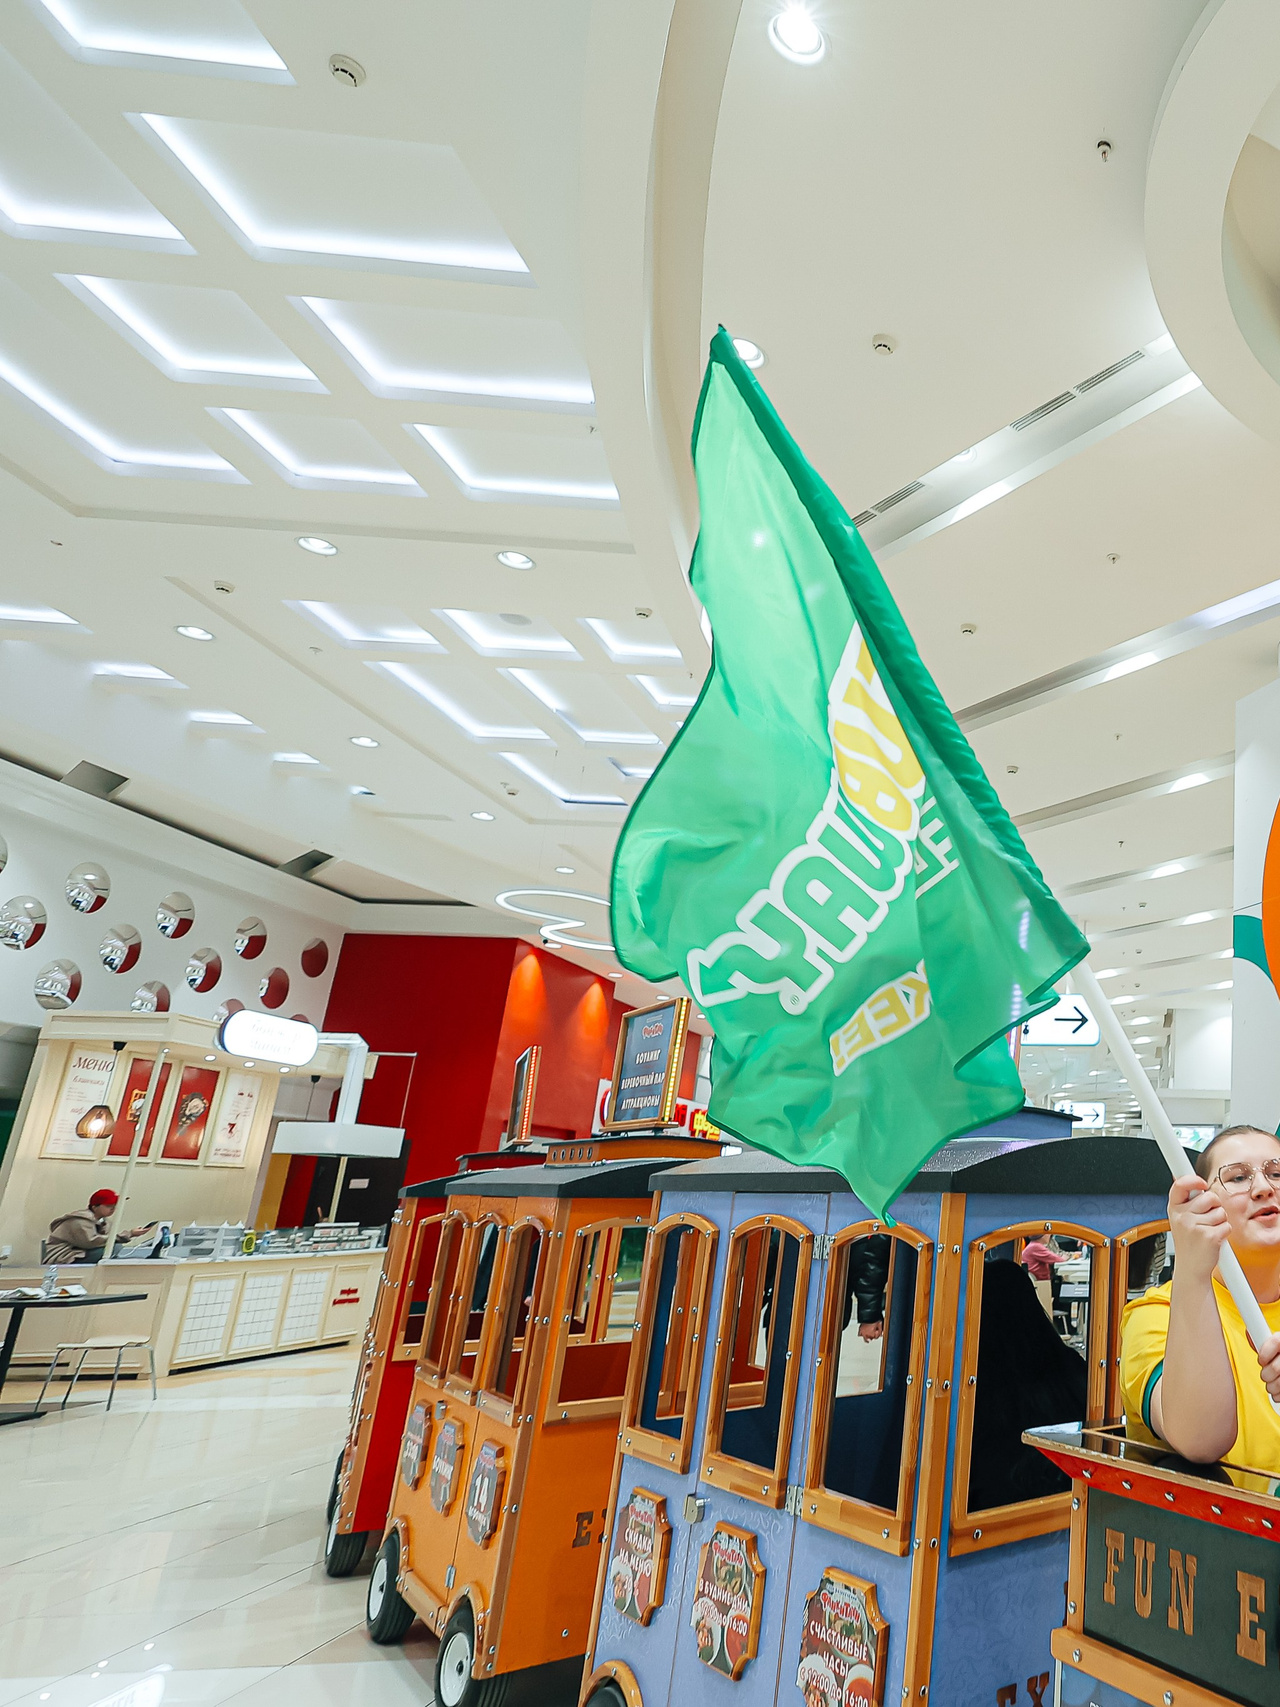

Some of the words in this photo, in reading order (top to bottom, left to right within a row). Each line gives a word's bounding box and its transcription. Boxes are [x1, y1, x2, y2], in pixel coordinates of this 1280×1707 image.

[655, 1072, 666, 1085] ПАР
[621, 1094, 661, 1111] АТТРАКЦИОНЫ
[625, 1528, 652, 1553] СКИДКА
[620, 1547, 629, 1566] НА
[630, 1554, 652, 1577] МЕНЮ
[1103, 1527, 1198, 1636] FUN
[699, 1579, 704, 1592] В
[704, 1580, 731, 1606] БУДНИЕ
[731, 1595, 748, 1614] ДНИ
[730, 1617, 748, 1637] 16:00
[809, 1620, 868, 1661] СЧАСТЛИВЫЕ
[823, 1651, 849, 1678] ЧАСЫ
[808, 1668, 830, 1693] 12:00
[830, 1683, 842, 1701] ДО
